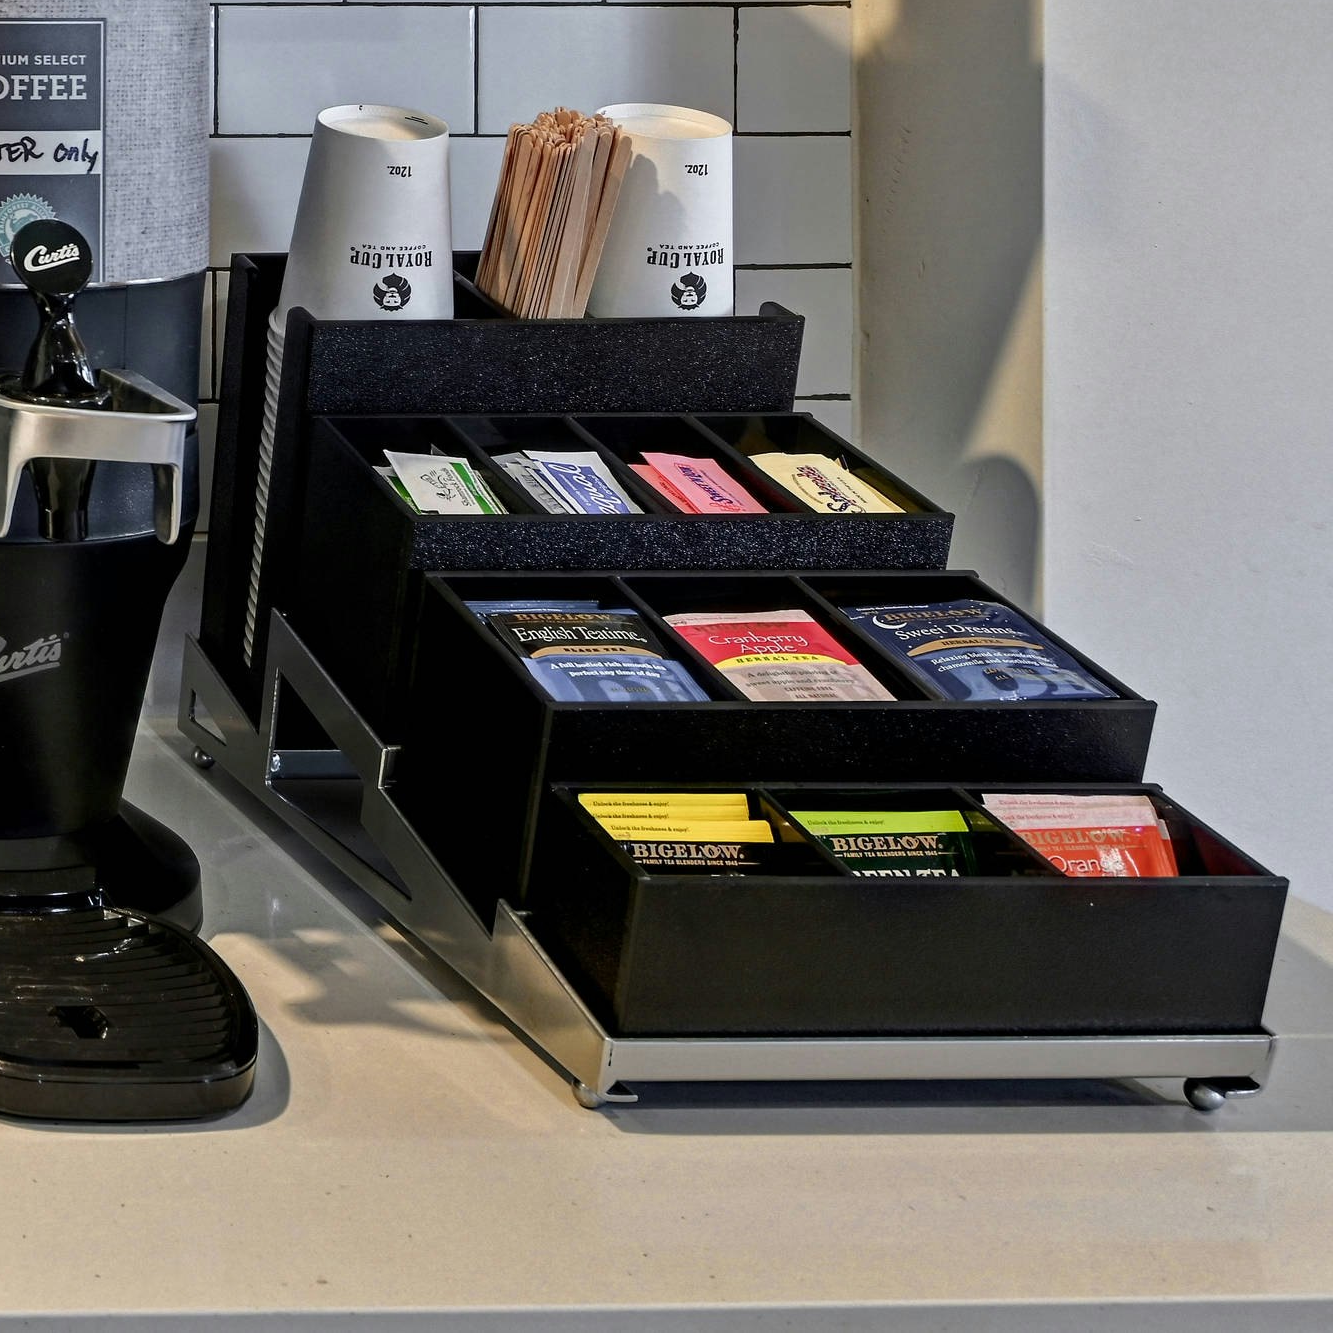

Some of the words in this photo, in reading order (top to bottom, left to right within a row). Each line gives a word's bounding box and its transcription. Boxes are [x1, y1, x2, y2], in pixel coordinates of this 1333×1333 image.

[34, 54, 86, 66] SELECT
[24, 242, 81, 272] Curtis
[385, 250, 433, 268] ROYAL
[683, 248, 724, 267] ROYAL
[512, 626, 579, 643] English
[708, 631, 809, 647] Cranberry
[894, 625, 946, 641] Sweet
[740, 640, 798, 655] Apple
[736, 655, 789, 664] HERBAL
[930, 652, 970, 665] Relaxing
[968, 651, 993, 659] blend
[937, 659, 985, 673] chamomile
[630, 843, 742, 859] BIGELOW
[829, 835, 939, 852] BIGELOW
